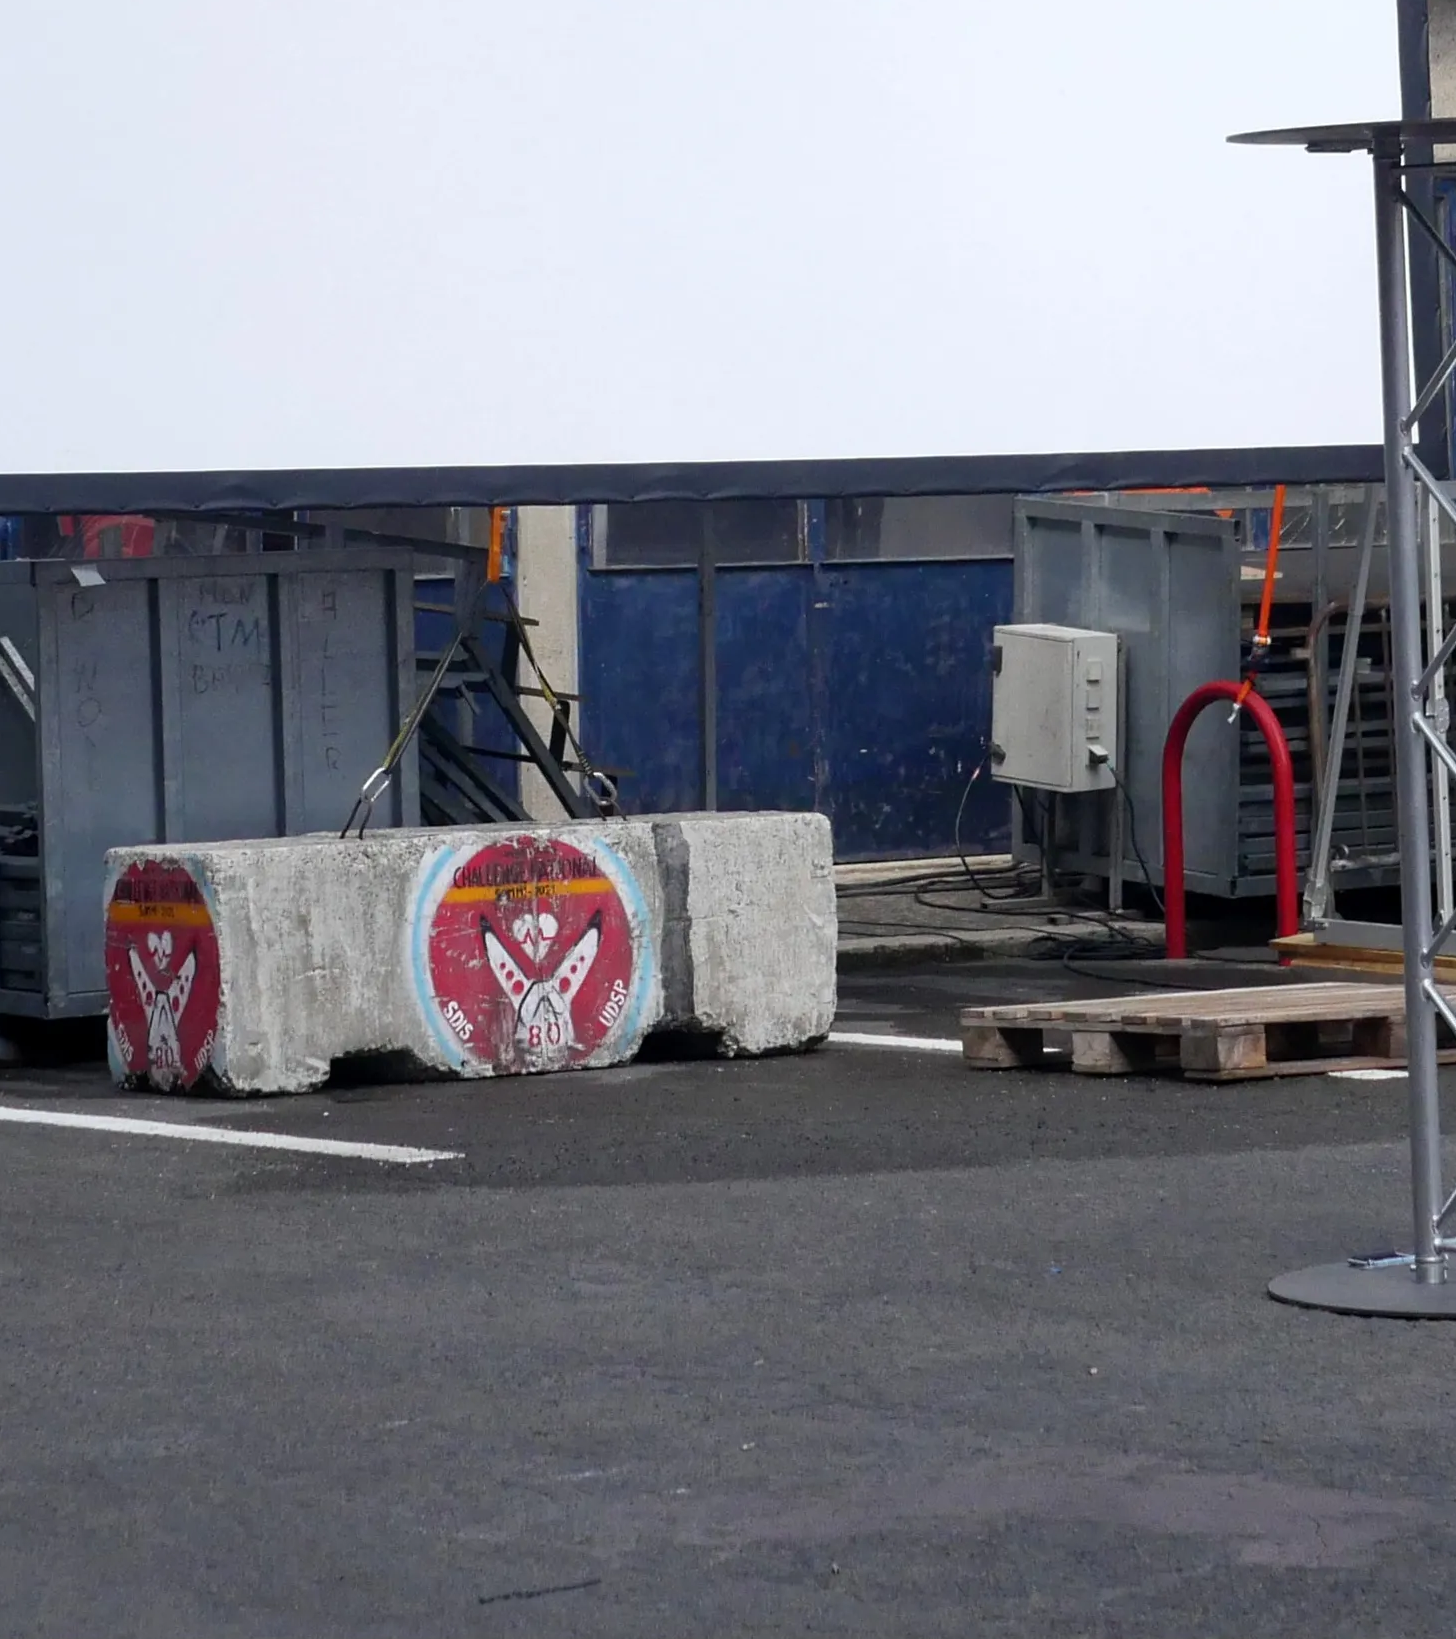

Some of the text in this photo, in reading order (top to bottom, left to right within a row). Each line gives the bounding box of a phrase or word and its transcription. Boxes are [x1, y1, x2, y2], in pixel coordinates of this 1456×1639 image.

[443, 1001, 474, 1041] SDIS
[598, 979, 629, 1027] UDSP
[193, 1029, 216, 1072] UDSP
[529, 1022, 561, 1048] 80
